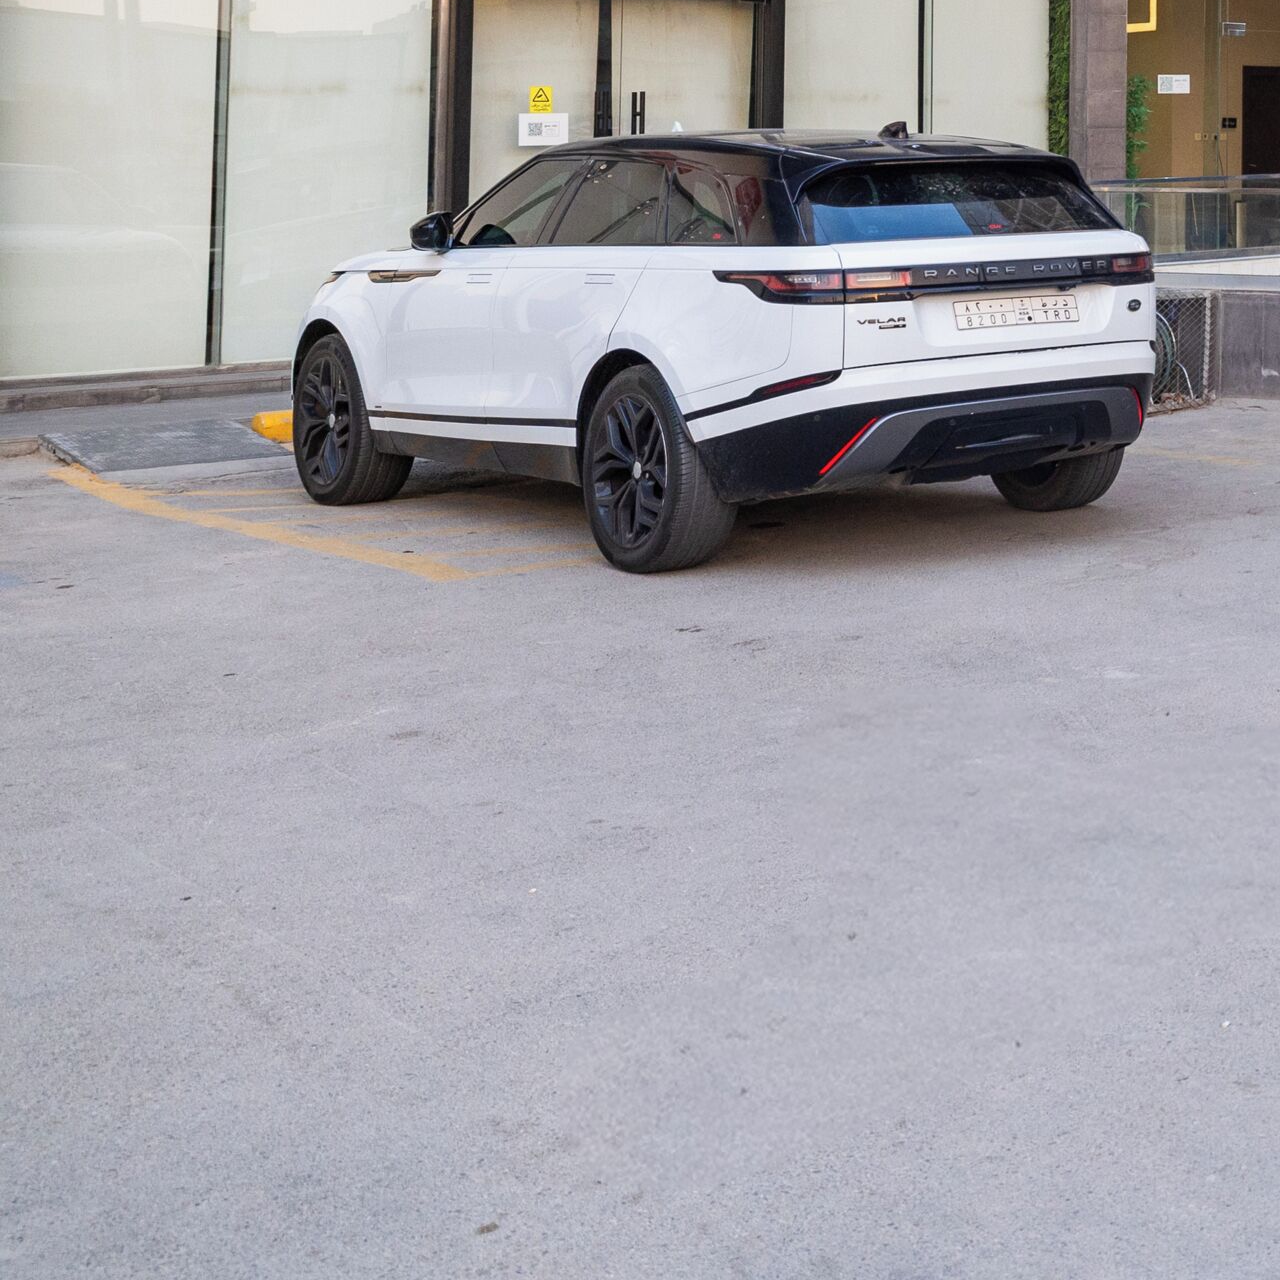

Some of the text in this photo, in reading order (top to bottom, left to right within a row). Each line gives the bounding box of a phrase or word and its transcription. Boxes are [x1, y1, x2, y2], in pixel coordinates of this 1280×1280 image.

[924, 260, 1107, 279] RANGE ROVER
[856, 316, 906, 325] VELAR
[967, 309, 1071, 327] 8200 TRD
